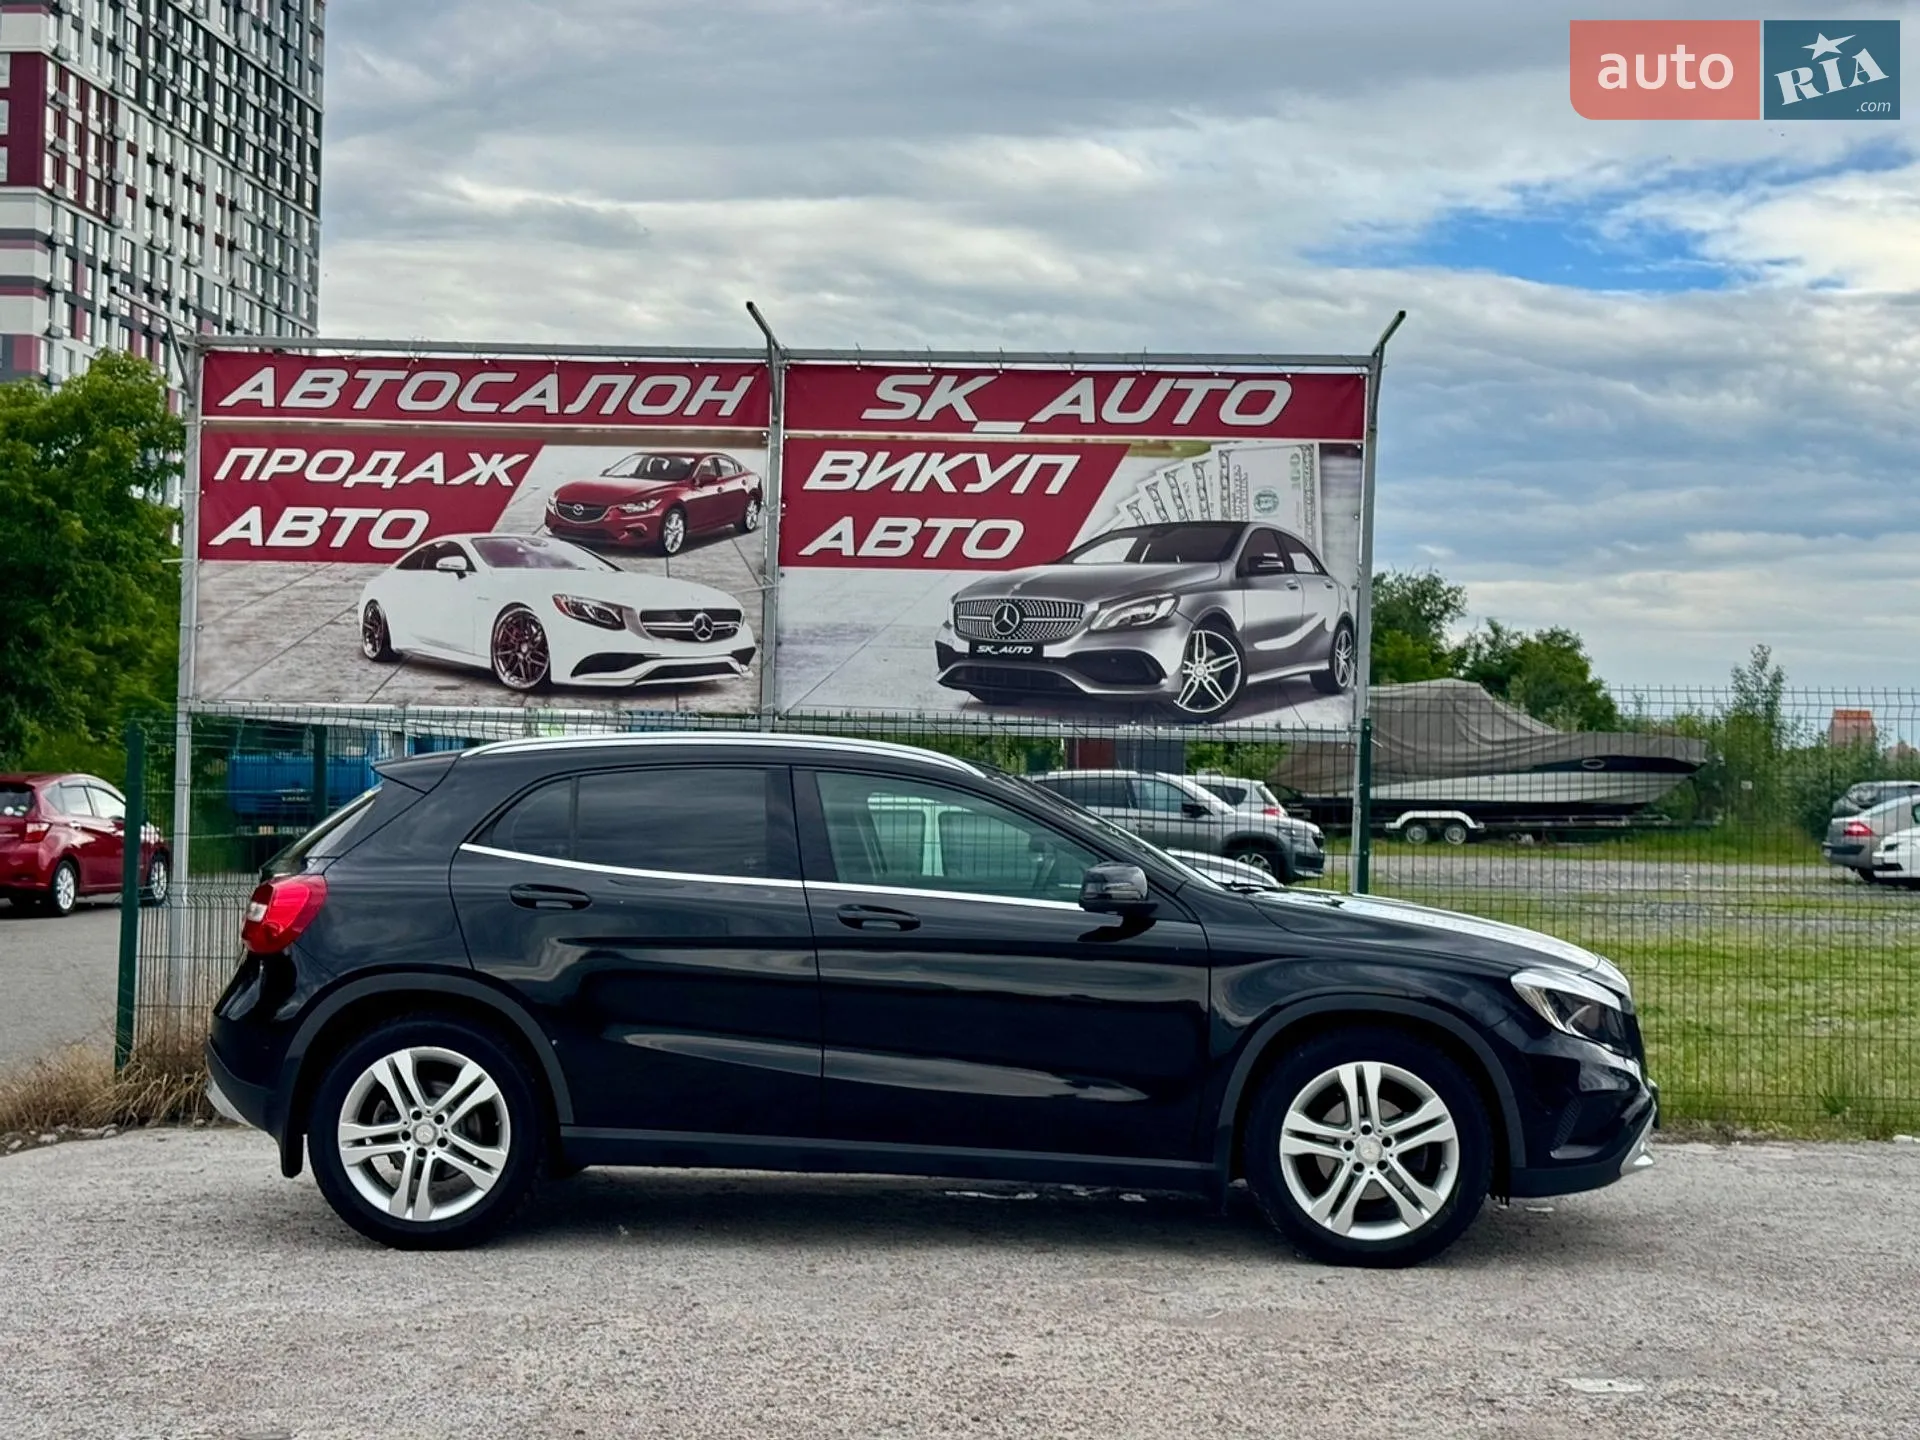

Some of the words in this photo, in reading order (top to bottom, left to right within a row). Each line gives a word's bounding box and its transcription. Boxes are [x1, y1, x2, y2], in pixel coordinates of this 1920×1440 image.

[218, 366, 754, 416] АВТОСАЛОН
[860, 374, 1292, 433] SK_AUTO
[213, 447, 529, 489] ПРОДАЖ
[802, 450, 1081, 495] ВИКУП
[207, 505, 430, 549] АВТО
[798, 516, 1025, 560] АВТО
[976, 645, 1033, 655] SK_AUTO
